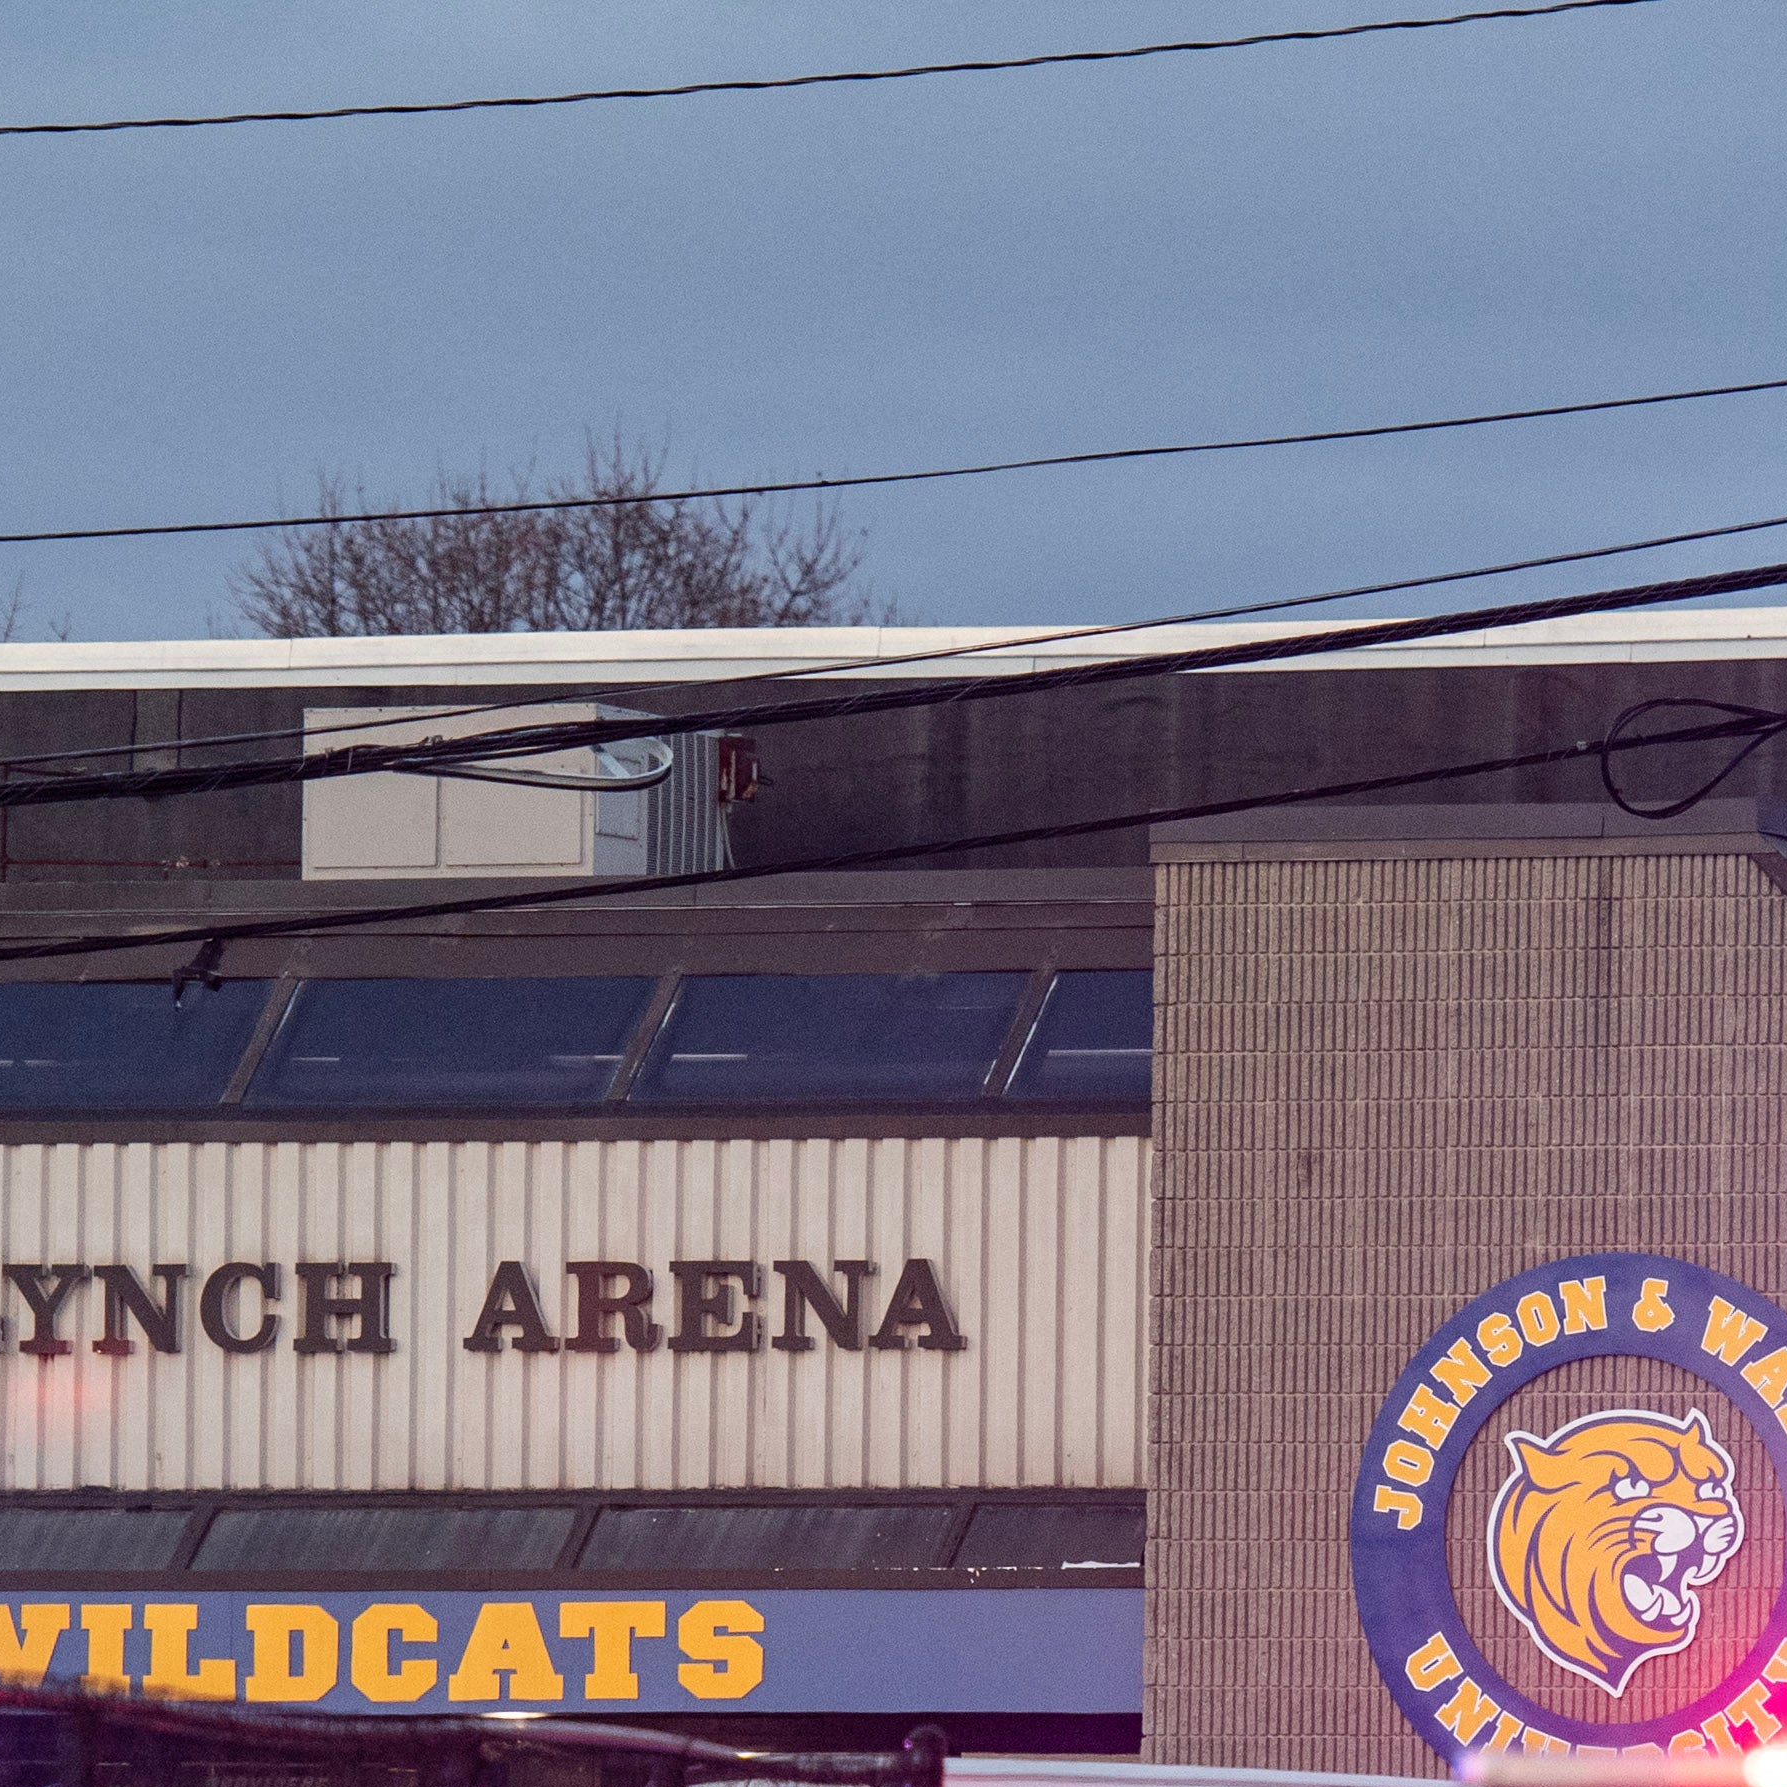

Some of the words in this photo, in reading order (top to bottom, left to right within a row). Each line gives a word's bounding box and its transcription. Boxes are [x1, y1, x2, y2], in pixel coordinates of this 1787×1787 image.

[462, 1257, 968, 1353] ARENA
[1373, 1274, 1607, 1532] JOHNSON
[1631, 1277, 1675, 1333] &
